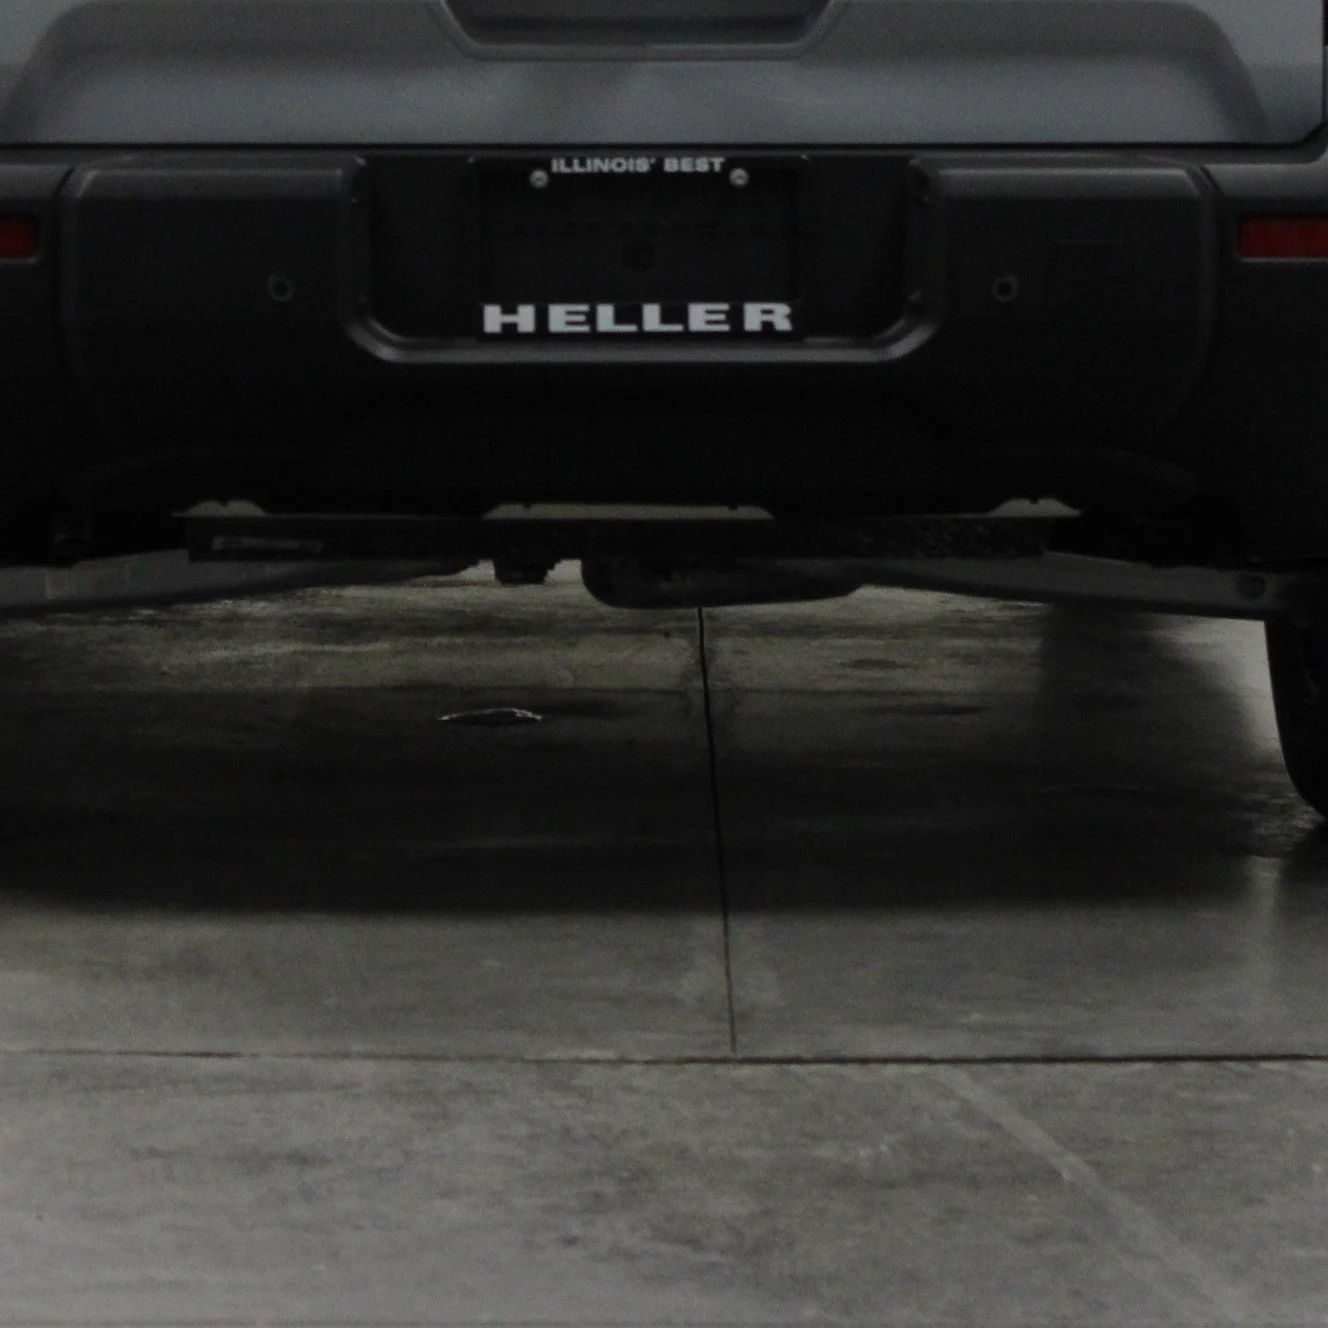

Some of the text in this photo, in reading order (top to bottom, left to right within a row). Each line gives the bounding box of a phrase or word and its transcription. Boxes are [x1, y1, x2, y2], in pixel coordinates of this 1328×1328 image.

[551, 156, 725, 174] ILLINOIS' BEST
[482, 302, 794, 334] HELLER
